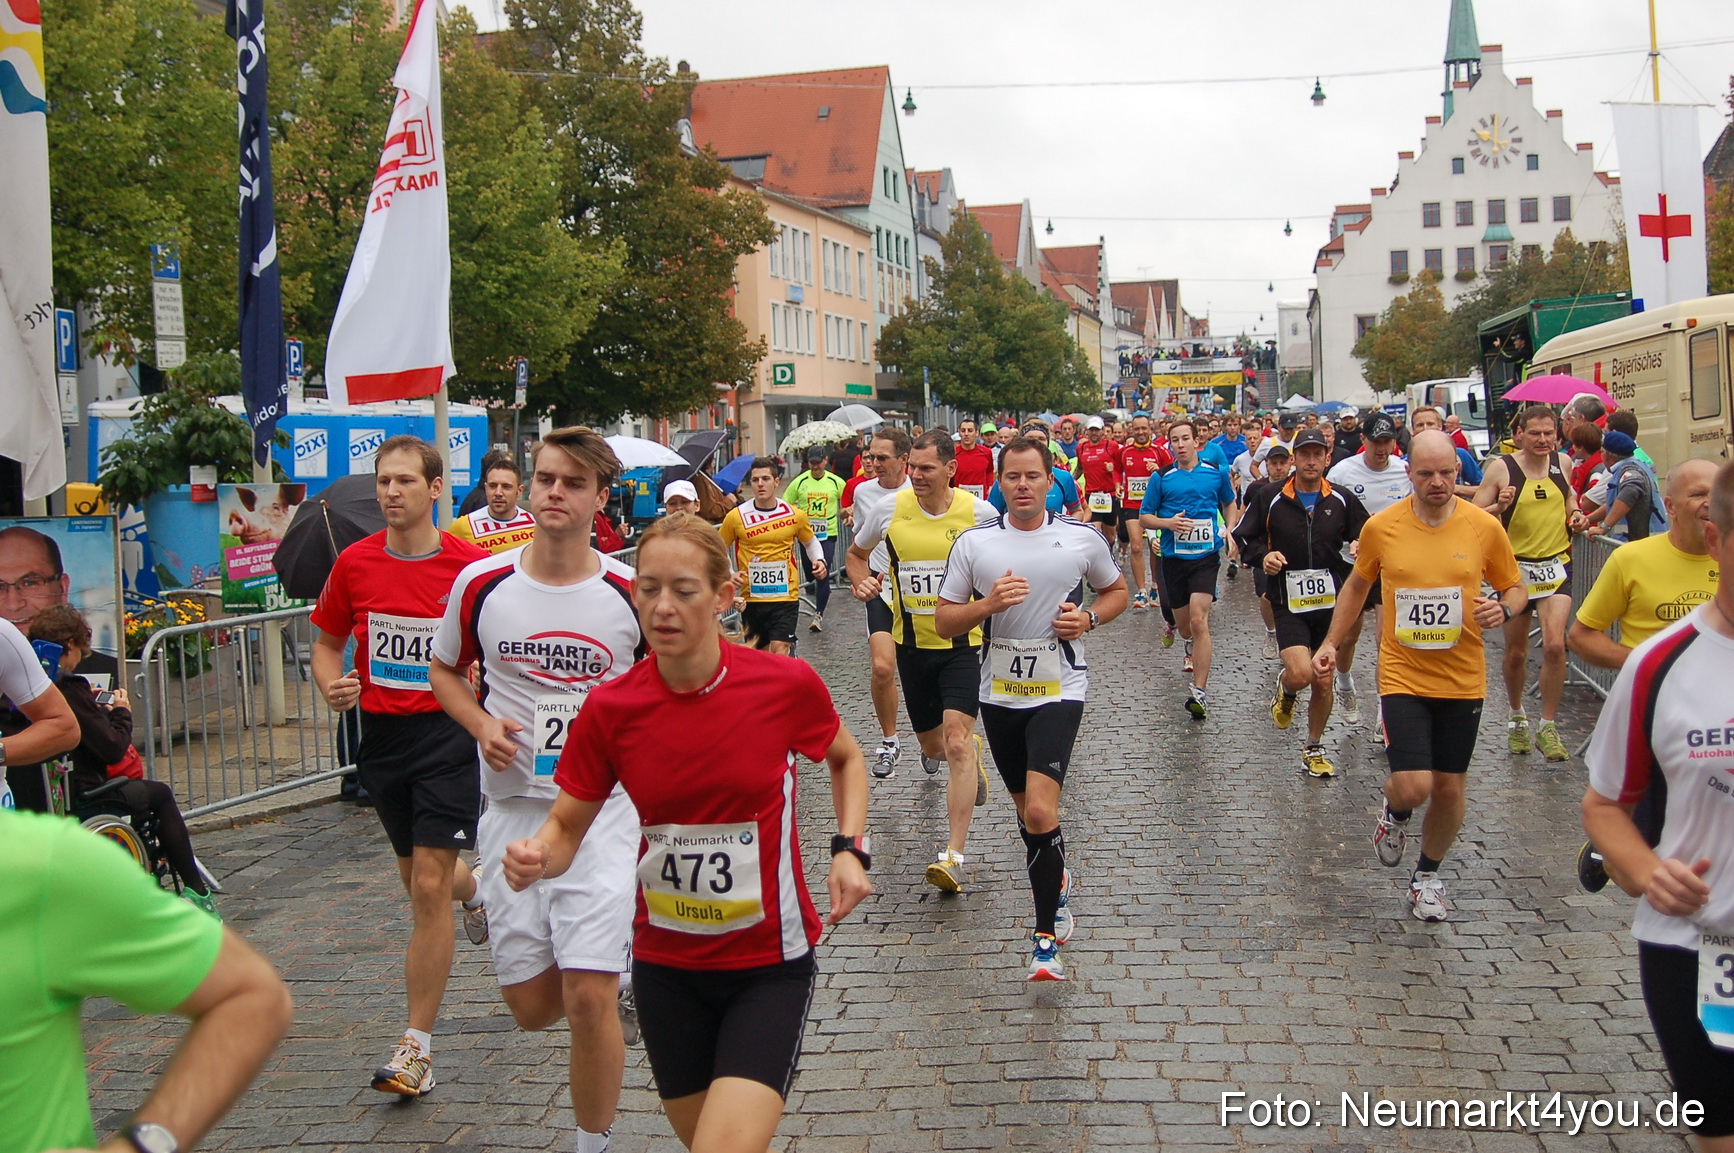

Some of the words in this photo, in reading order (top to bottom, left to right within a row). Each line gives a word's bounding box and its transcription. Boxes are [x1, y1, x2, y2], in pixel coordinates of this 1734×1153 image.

[60, 317, 71, 364] P
[289, 345, 300, 374] P
[1612, 350, 1662, 379] Bayerisches
[775, 365, 792, 383] D
[1181, 375, 1212, 385] START
[1612, 381, 1636, 400] Rotes
[1690, 430, 1720, 444] Bayerisches
[812, 501, 823, 511] M
[746, 526, 770, 539] MAX
[772, 519, 798, 531] BÖGL
[477, 536, 508, 549] MAX
[229, 556, 252, 568] BEIDE
[249, 562, 273, 574] GRÜN
[752, 570, 785, 585] 2854
[1529, 566, 1557, 583] 438
[1296, 578, 1327, 596] 198
[1418, 593, 1451, 601] Neumarkt
[1408, 602, 1450, 626] 452
[370, 619, 394, 630] PARTL
[395, 623, 434, 633] Neumarkt
[1412, 631, 1446, 641] Markus
[375, 631, 434, 662] 2048
[497, 640, 592, 661] GERHART
[991, 642, 1012, 652] PARTL
[1012, 644, 1047, 653] Neumarkt
[383, 665, 429, 681] Matthias
[500, 655, 541, 665] Autohaus
[540, 655, 603, 675] JÄNIG
[1009, 655, 1038, 679] 47
[1004, 682, 1047, 696] Wolfgang
[537, 703, 570, 713] PARTL
[1707, 775, 1730, 794] Das
[647, 833, 671, 846] PARTL
[673, 834, 735, 847] Neumarkt
[660, 851, 734, 894] 473
[675, 900, 724, 921] Ursula
